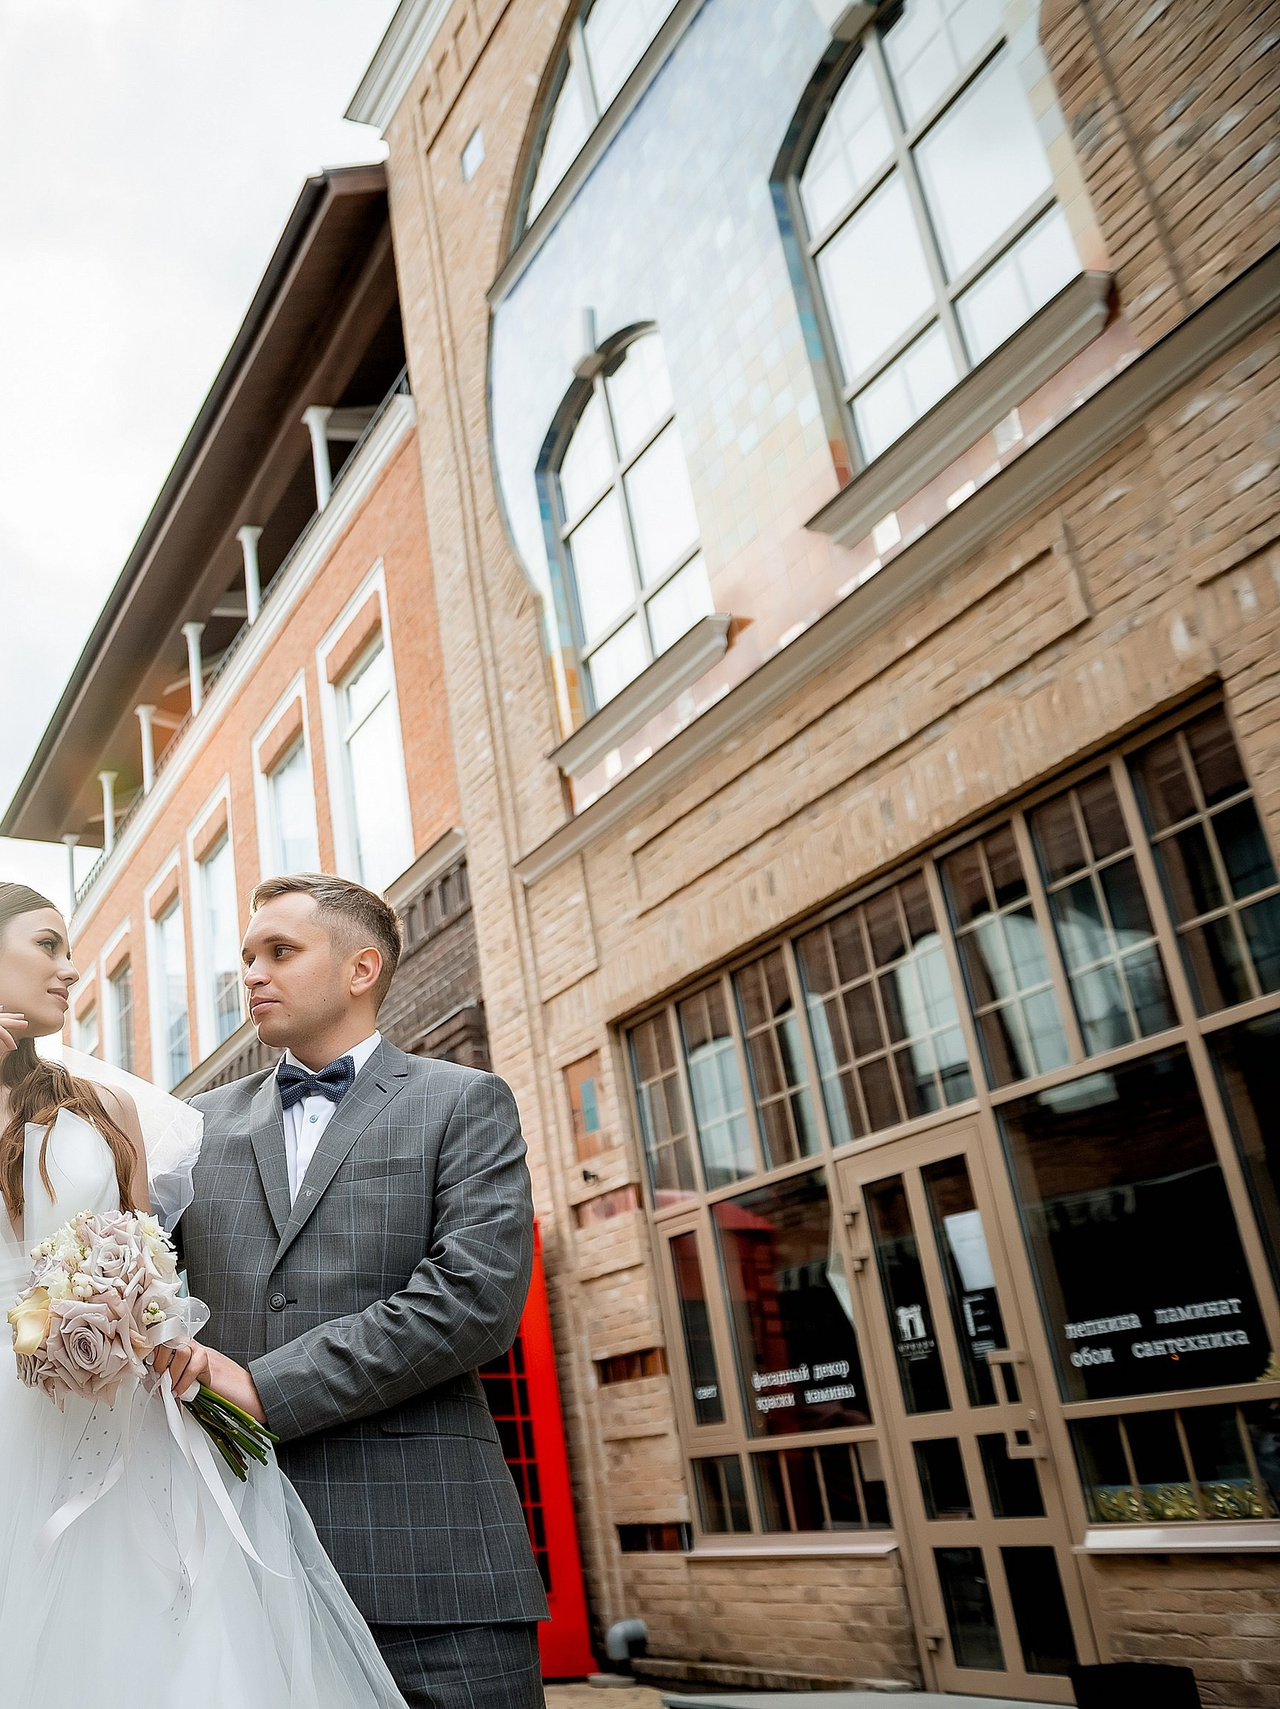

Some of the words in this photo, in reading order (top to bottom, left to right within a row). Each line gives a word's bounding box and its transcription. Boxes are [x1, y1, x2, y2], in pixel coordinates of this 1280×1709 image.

[1064, 1313, 1142, 1339] лепнина
[1154, 1298, 1241, 1324] ламинат
[1070, 1346, 1115, 1367] обои
[1131, 1329, 1250, 1358] сантехника
[752, 1363, 810, 1391] фасадный
[813, 1360, 849, 1381] декор
[755, 1392, 795, 1413] краски
[804, 1383, 856, 1404] камины
